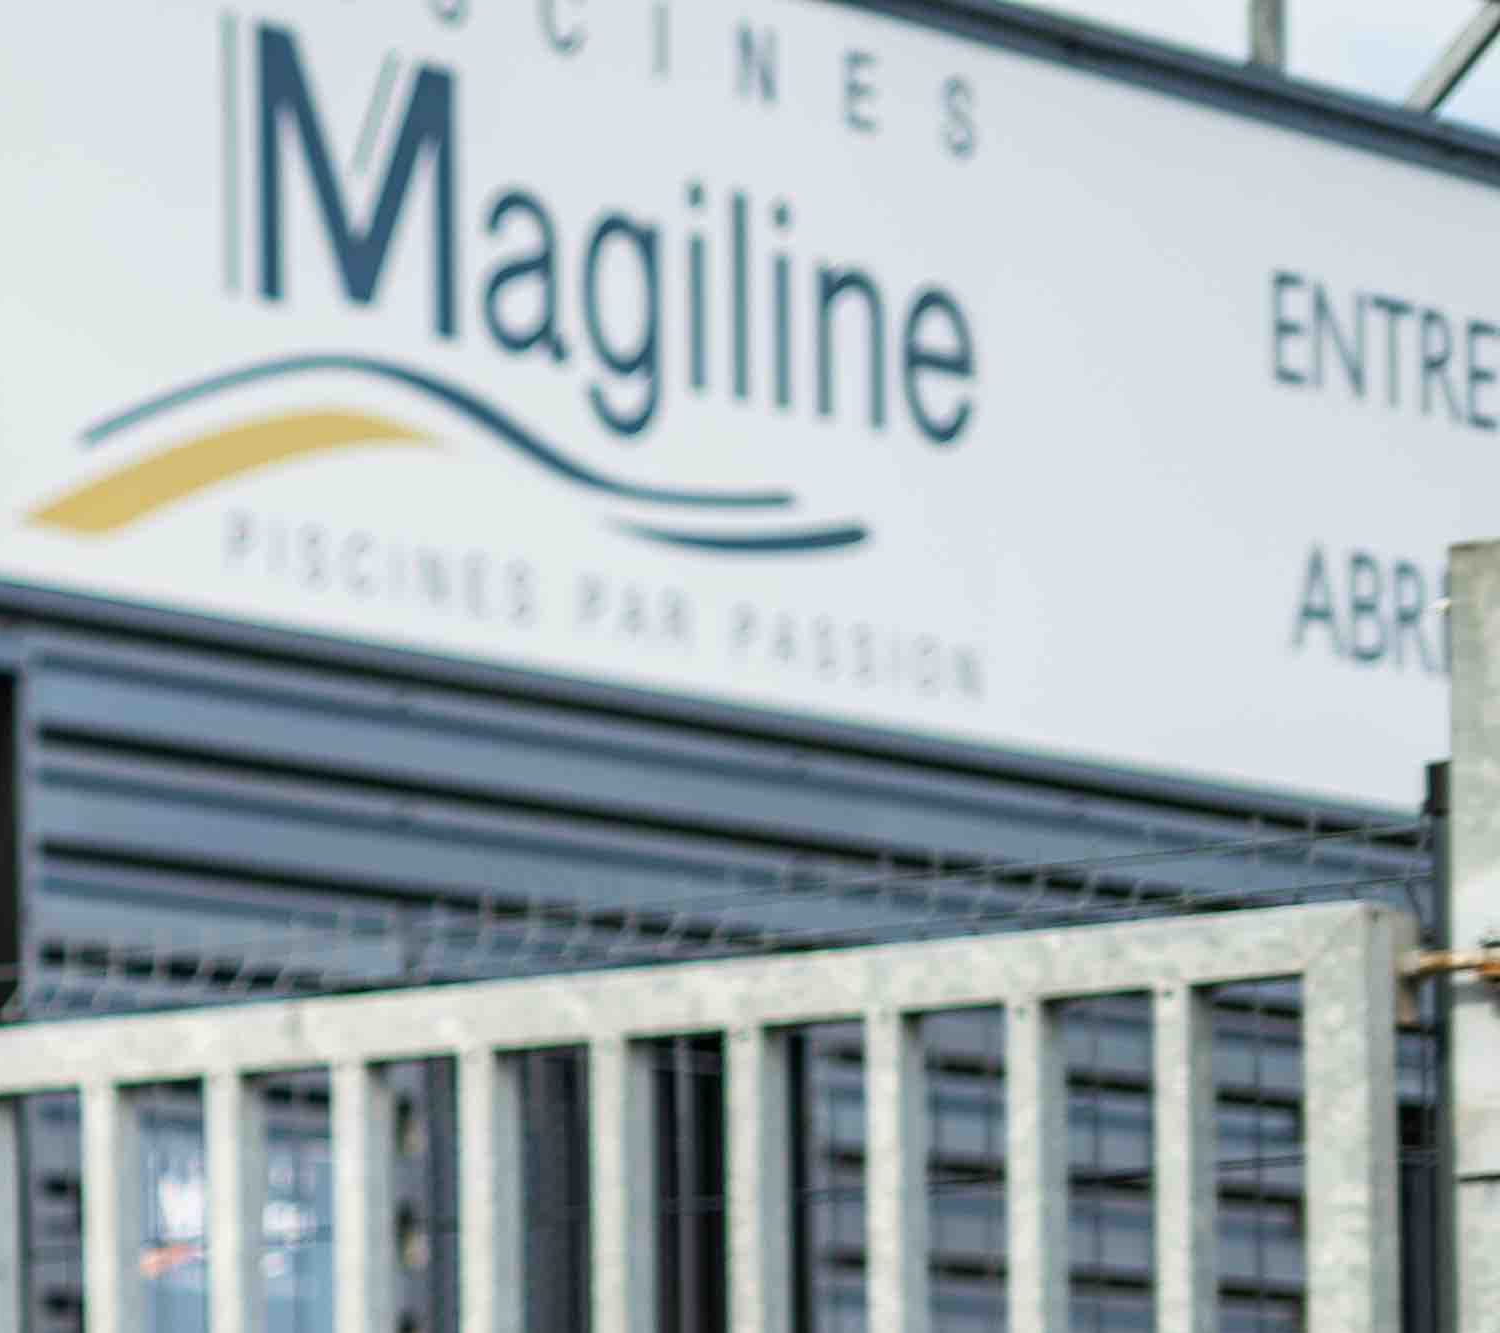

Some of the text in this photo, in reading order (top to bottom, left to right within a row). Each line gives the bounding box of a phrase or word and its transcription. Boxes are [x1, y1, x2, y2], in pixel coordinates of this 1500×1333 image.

[248, 20, 976, 445] Magiline
[224, 508, 985, 703] PISCINES PAR PASSION
